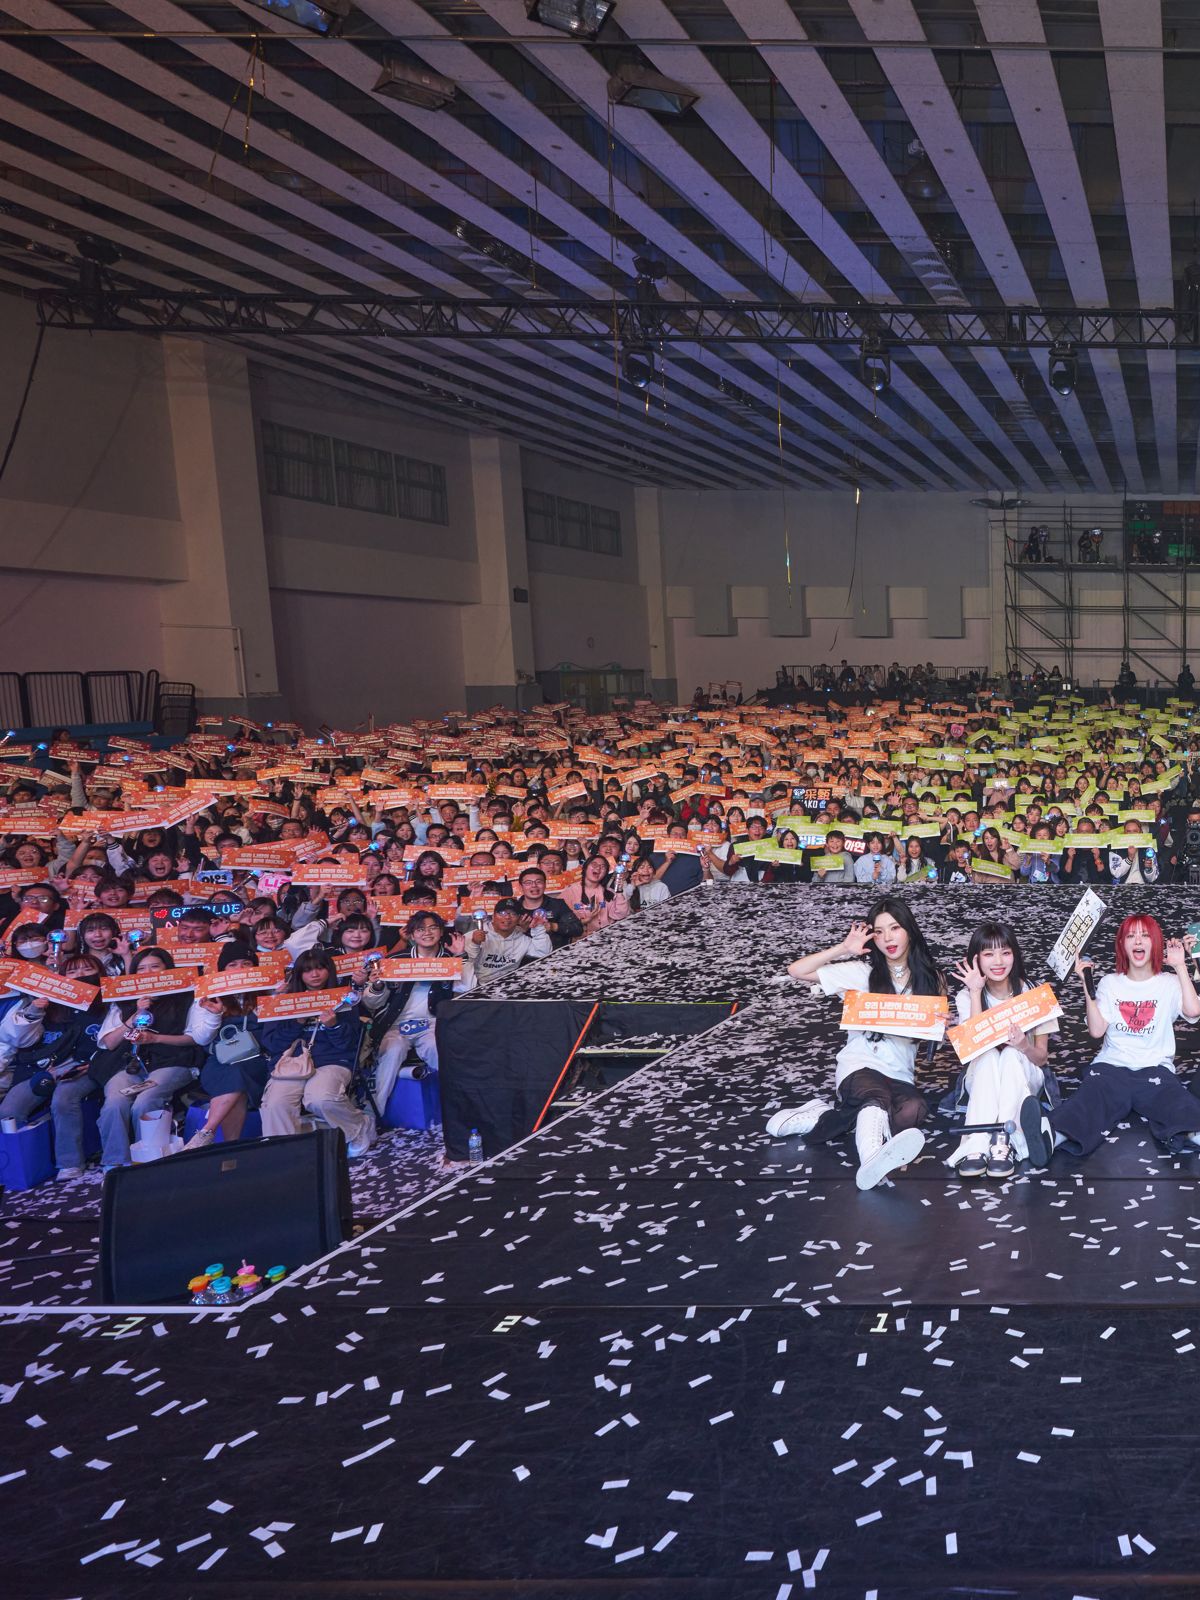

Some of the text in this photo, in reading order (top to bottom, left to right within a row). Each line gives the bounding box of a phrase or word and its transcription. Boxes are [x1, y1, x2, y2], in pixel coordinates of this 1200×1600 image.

[1116, 1022, 1155, 1034] Concert!
[1128, 1016, 1145, 1026] Fan
[492, 1315, 522, 1332] 2
[869, 1313, 888, 1332] 1
